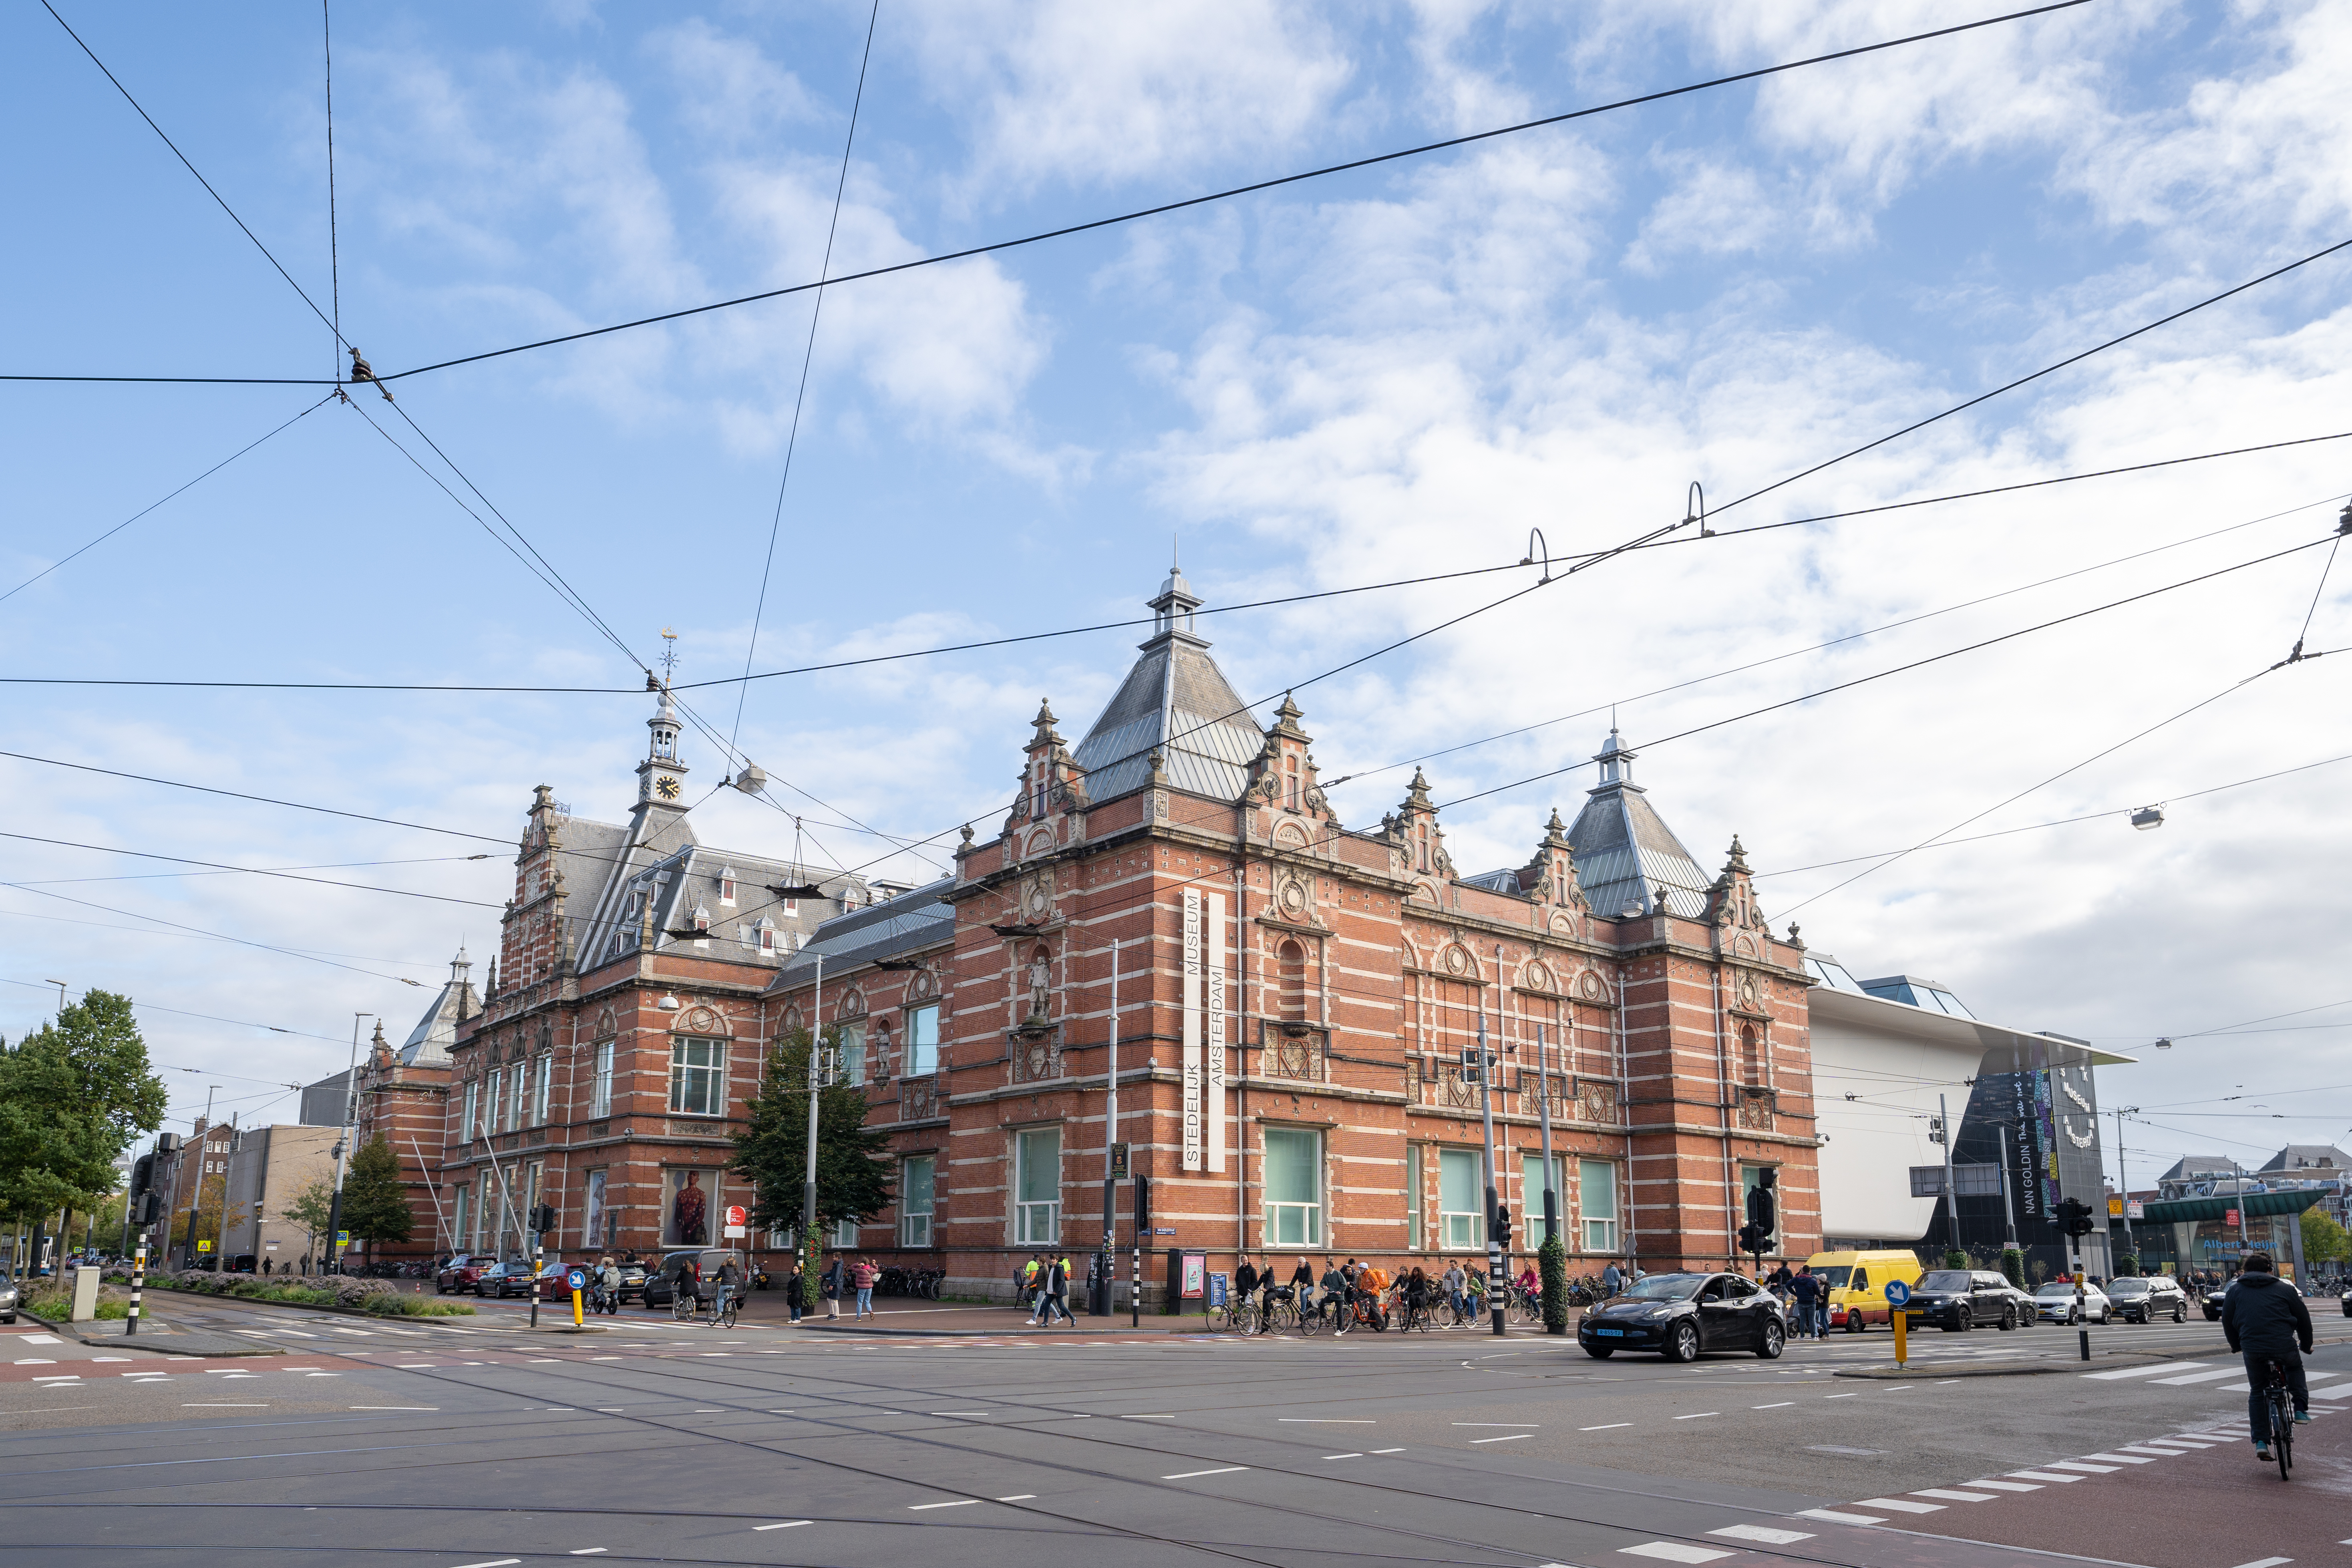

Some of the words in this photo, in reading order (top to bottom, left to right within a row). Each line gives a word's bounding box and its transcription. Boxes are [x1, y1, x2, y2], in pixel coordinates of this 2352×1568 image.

[1187, 896, 1198, 975] MUSEUM
[1212, 971, 1222, 1087] AMSTERDAM
[2034, 1071, 2044, 1100] KUSAMA
[2042, 1082, 2051, 1108] KOONS
[2063, 1081, 2090, 1113] MUSEUM
[1187, 1063, 1198, 1162] STEDELIJK
[2063, 1115, 2094, 1148] AMSTERDAM
[2020, 1145, 2033, 1187] GOLDIN
[2042, 1138, 2052, 1169] ANATSUI
[2049, 1152, 2058, 1179] DUMAS
[2024, 1191, 2035, 1213] NAN
[2203, 1240, 2241, 1249] Albert
[2247, 1240, 2278, 1250] Heijn
